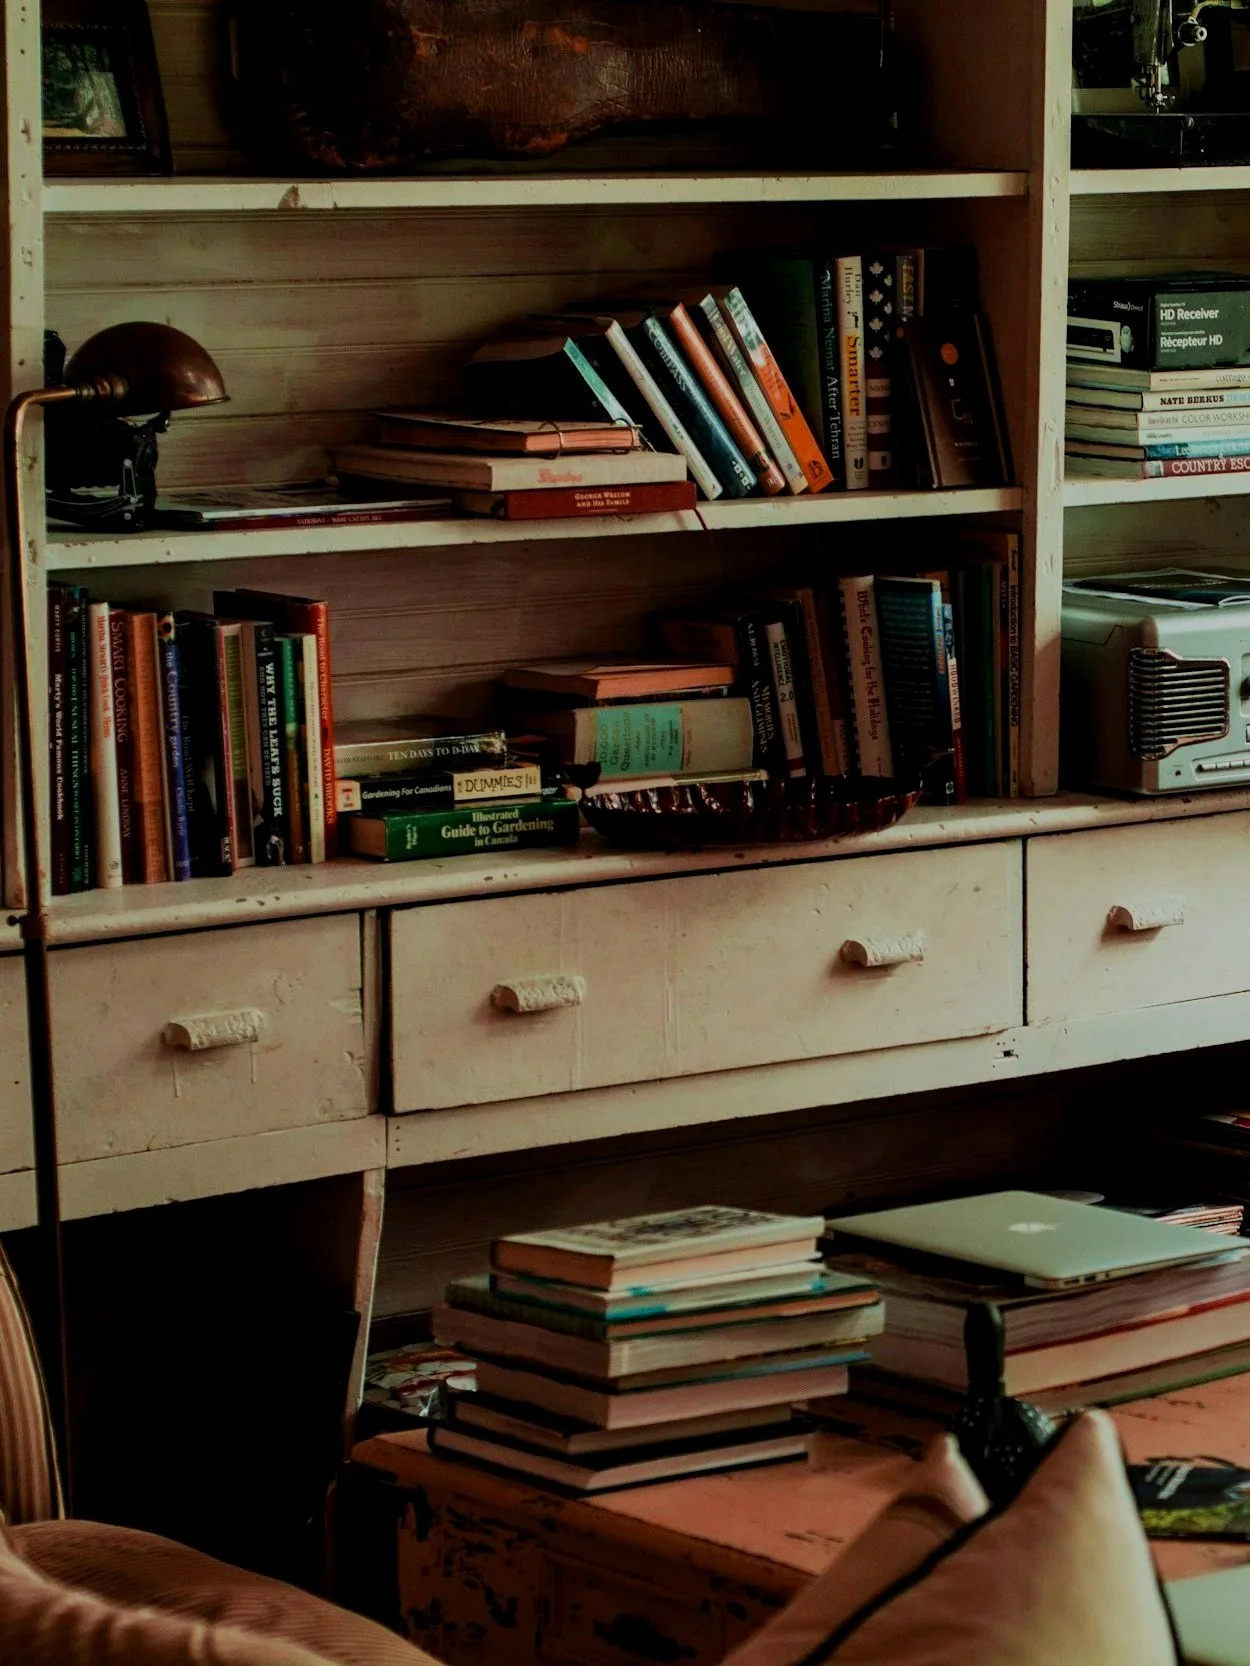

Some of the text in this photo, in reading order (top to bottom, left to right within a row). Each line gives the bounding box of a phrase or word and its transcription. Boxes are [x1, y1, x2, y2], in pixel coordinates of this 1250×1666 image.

[843, 266, 853, 304] Hurley
[1160, 307, 1219, 321] HD Receiver
[1160, 334, 1223, 349] Récepteur HD
[820, 275, 843, 459] Marina Nemat After Tehran
[846, 335, 863, 415] Smarter
[1160, 396, 1184, 406] NATE
[1187, 394, 1224, 404] BERKUS
[1181, 412, 1211, 425] COLOR
[1172, 456, 1227, 475] COUNTRY
[574, 490, 630, 501] GEORGE WESTON
[592, 499, 605, 507] HIS
[606, 497, 629, 506] FAMILY
[1008, 584, 1016, 635] Introduction
[97, 615, 107, 640] Martha
[316, 617, 326, 635] The
[317, 637, 327, 662] Road
[859, 625, 873, 667] Cooking
[1009, 645, 1017, 672] BASIC
[258, 665, 267, 683] AND
[772, 641, 785, 688] INTELLIGENCE
[779, 638, 791, 685] EMOTIONAL
[865, 666, 875, 682] for
[111, 621, 128, 743] SMART COOKING
[260, 685, 268, 704] HOW
[866, 682, 878, 697] the
[949, 663, 960, 723] HOODWINKED
[164, 651, 181, 768] the Country garden
[319, 673, 330, 721] Character
[1009, 673, 1018, 727] GARDENING
[261, 706, 269, 727] THEY
[867, 697, 881, 740] Holidays
[54, 673, 65, 821] Marty's World Famous Cookbook
[262, 729, 270, 747] CAN
[265, 662, 284, 816] WHY THE LEAFS SUCK
[609, 720, 620, 764] Garden
[620, 711, 631, 771] Questions
[388, 742, 481, 762] TEN DAYS TO D-DAY
[264, 762, 272, 786] FIXED
[322, 748, 335, 824] DAVID BROOKS
[464, 773, 524, 795] DUMMIES
[119, 768, 131, 838] ANNE LINDSAY
[362, 785, 402, 799] Gardening
[403, 785, 413, 796] For
[414, 782, 452, 796] Canadians
[472, 808, 520, 823] Illustrated
[441, 817, 555, 840] Guide to Gardening
[474, 833, 518, 847] in Canada
